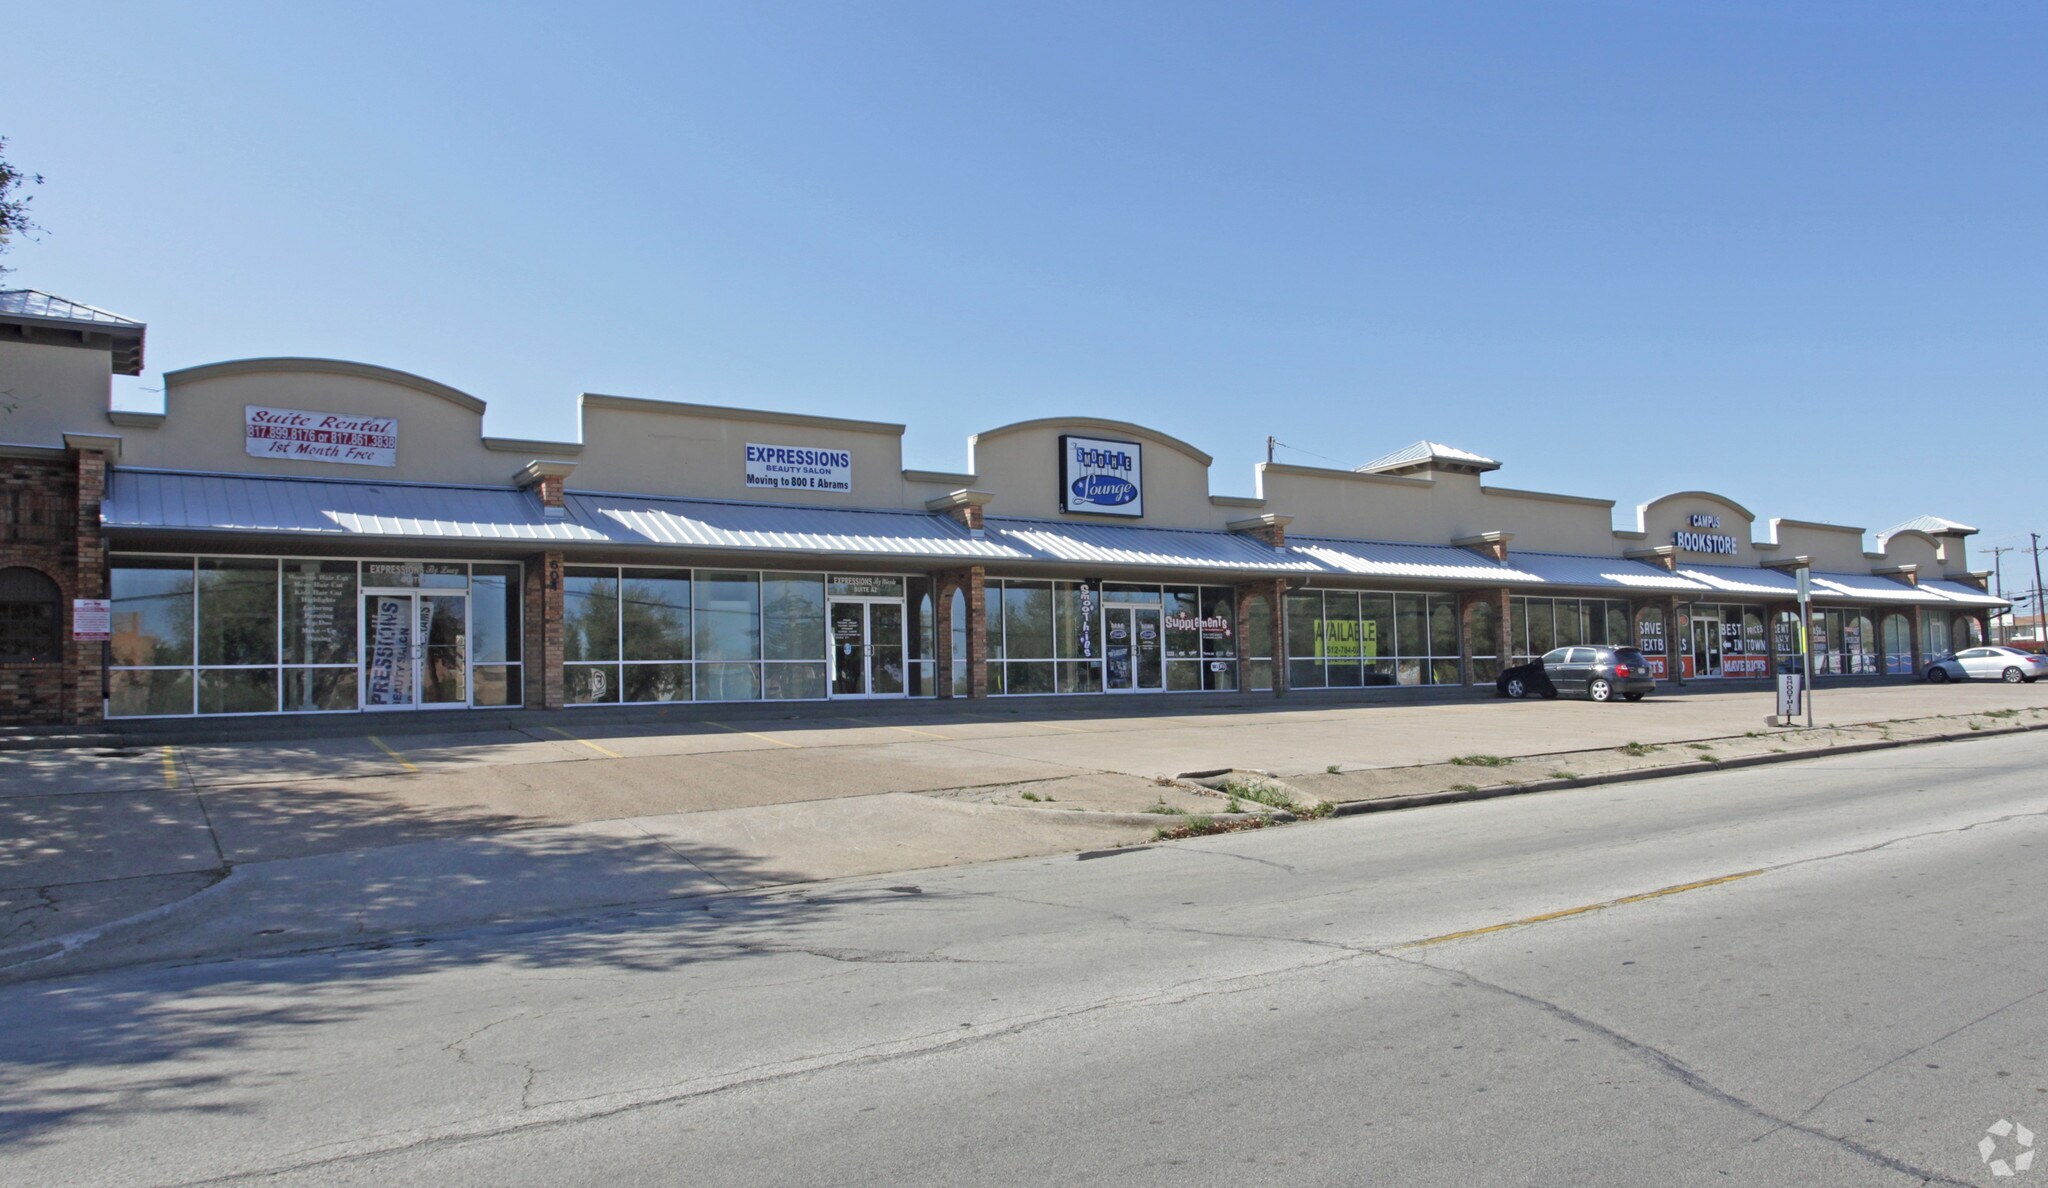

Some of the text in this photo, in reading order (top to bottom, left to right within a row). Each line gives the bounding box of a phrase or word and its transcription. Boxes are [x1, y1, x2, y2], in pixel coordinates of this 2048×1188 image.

[251, 410, 392, 433] Suite Rental
[248, 425, 396, 448] 817.899.8176 or 817.861.3838
[268, 441, 375, 460] 1st Month Free
[746, 446, 849, 468] EXPRESSIONS
[1077, 448, 1131, 471] SMOOTHIE
[766, 464, 831, 475] BEAUTY SALON
[746, 474, 849, 489] Moving to 800 E Abrams
[1072, 474, 1132, 505] Lounge
[1692, 514, 1721, 528] CAMPUS
[1677, 531, 1737, 555] BOOKSTORE
[370, 564, 425, 574] EXPRESSIONS
[833, 576, 873, 585] EXPRESSIONS
[1640, 622, 1662, 634] SAVE
[1721, 623, 1741, 636] BEST
[1776, 623, 1789, 634] ENT
[1734, 639, 1766, 651] IN TOWN
[1723, 660, 1766, 672] MAVERICKS
